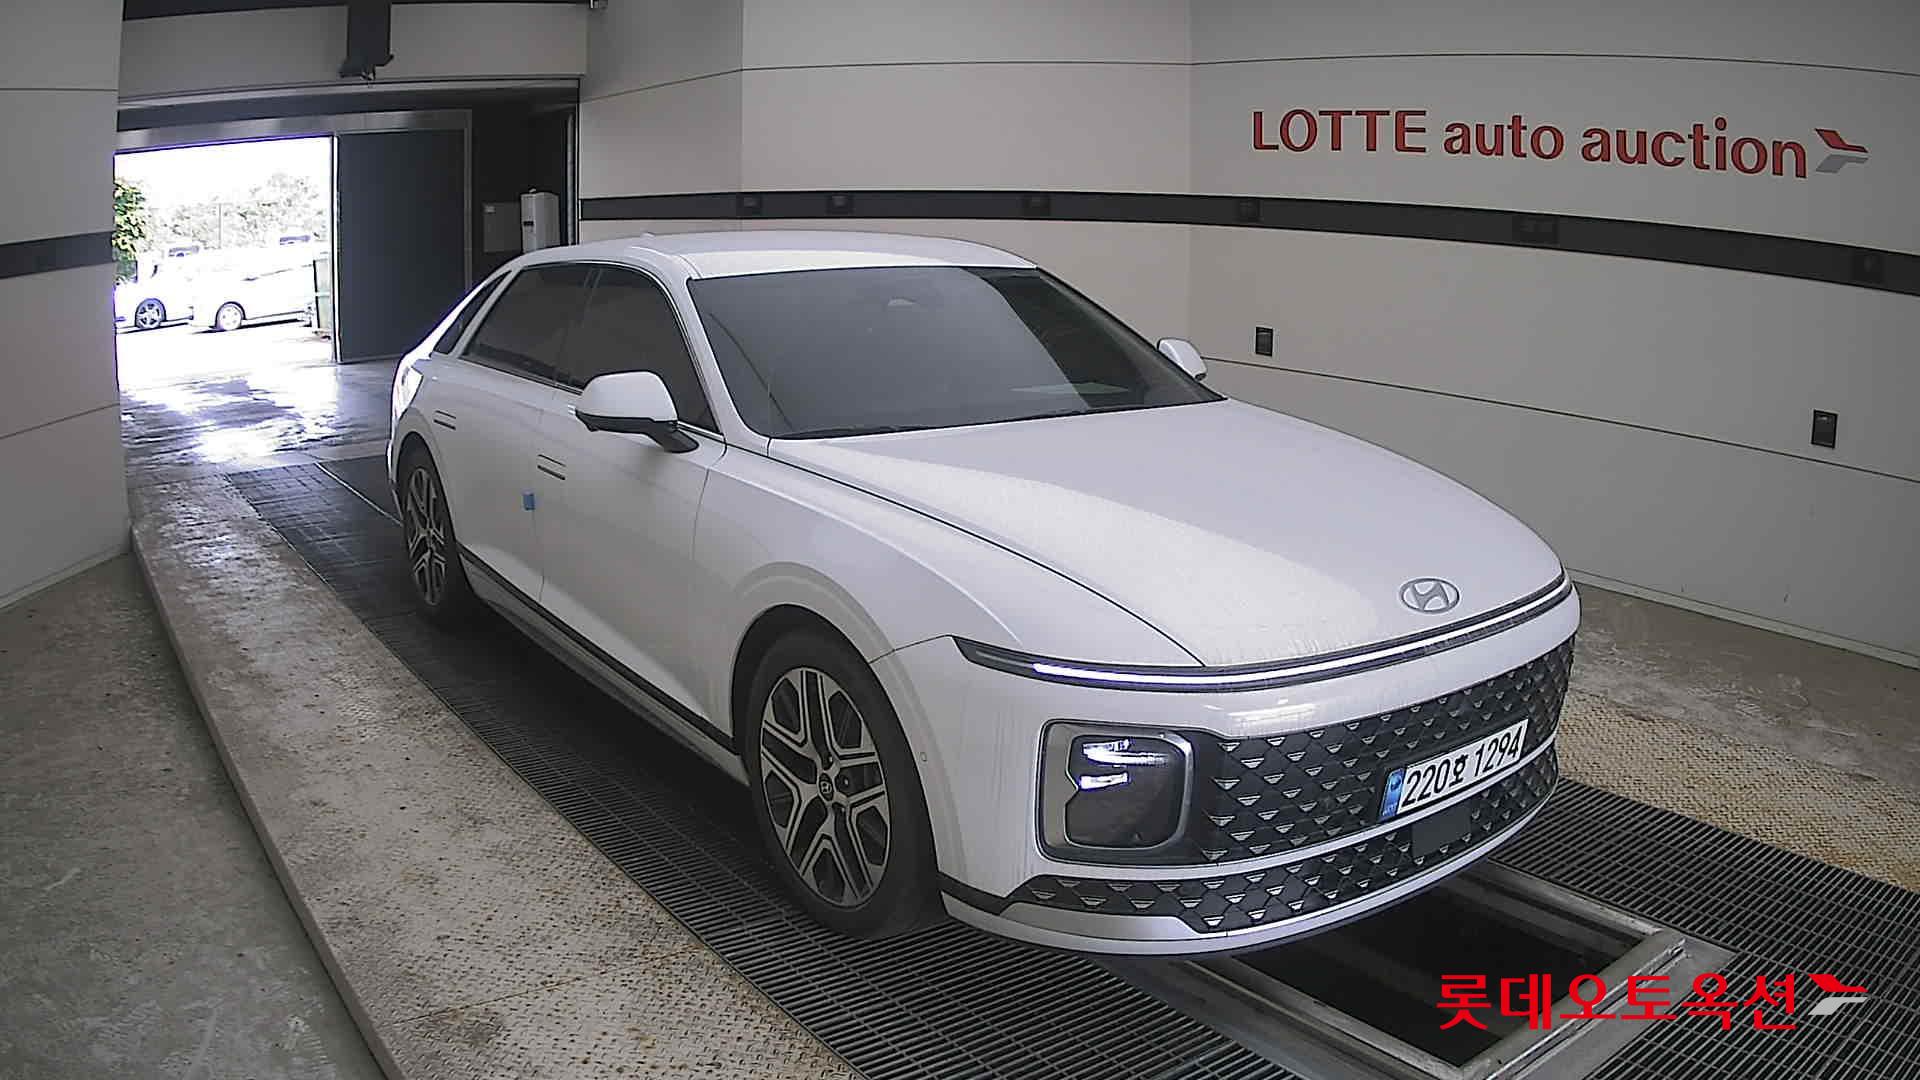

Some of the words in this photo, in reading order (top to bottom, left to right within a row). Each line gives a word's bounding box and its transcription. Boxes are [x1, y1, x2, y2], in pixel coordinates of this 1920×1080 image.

[1253, 109, 1427, 153] LOTTE
[1444, 115, 1565, 160] auto
[1582, 117, 1808, 179] auction
[1474, 726, 1522, 777] 1294
